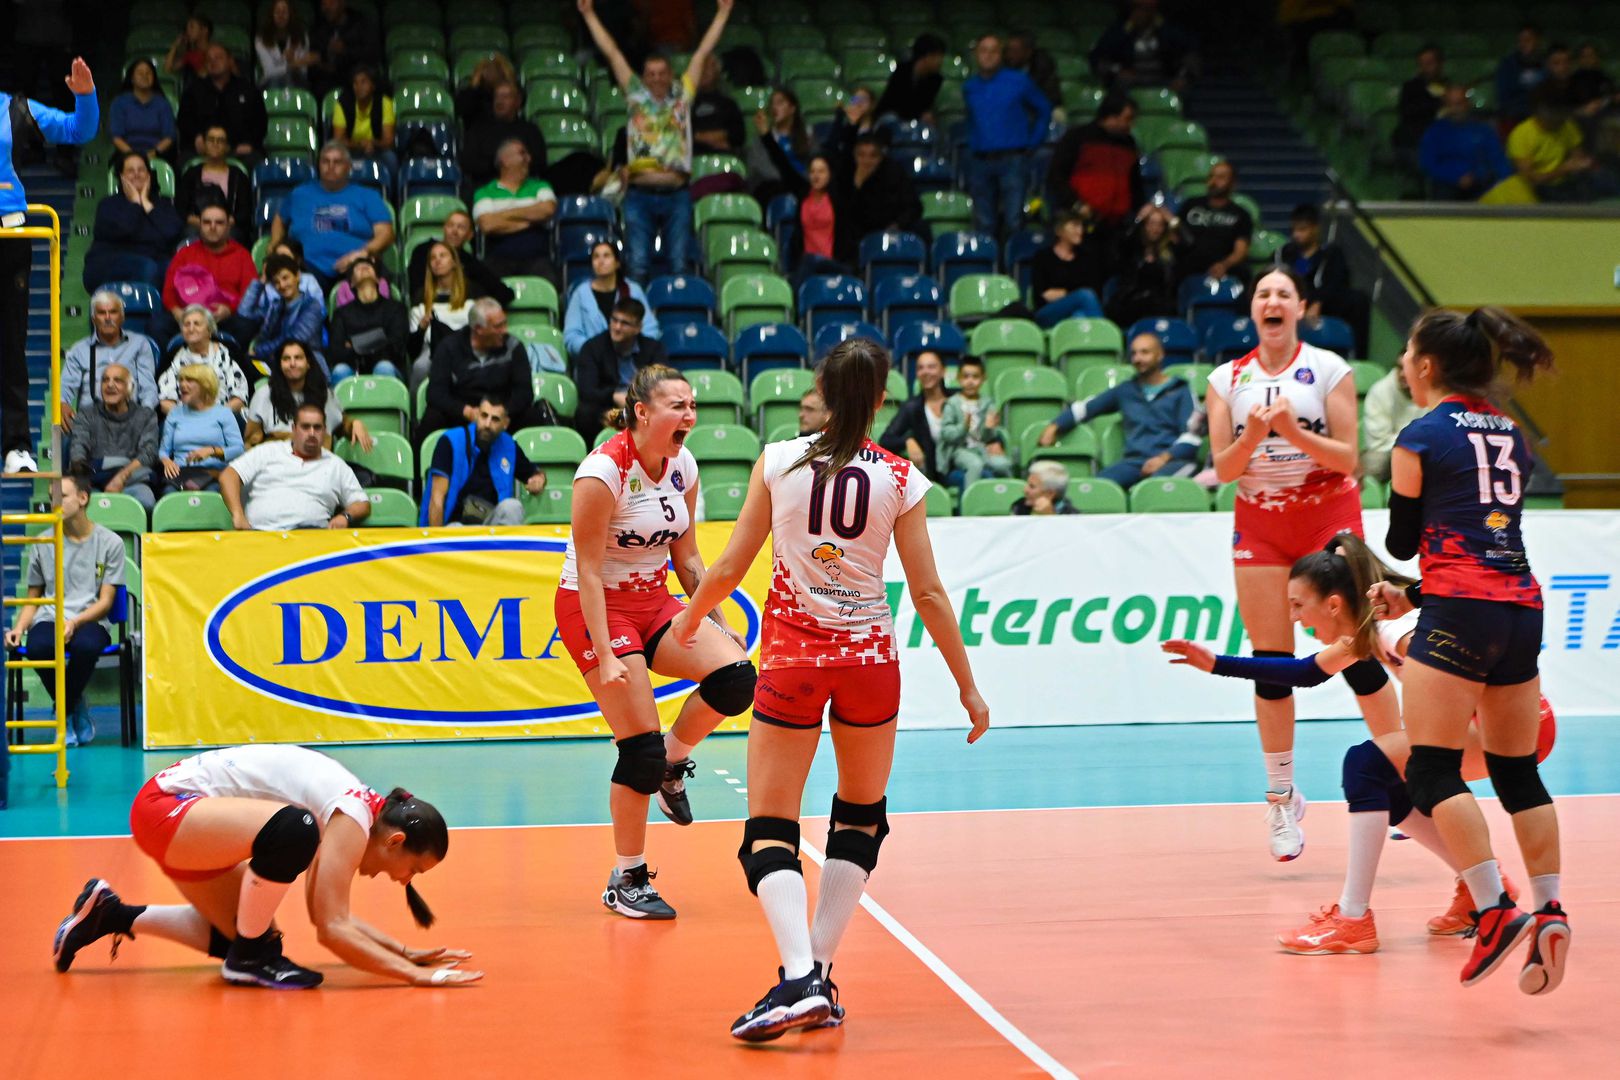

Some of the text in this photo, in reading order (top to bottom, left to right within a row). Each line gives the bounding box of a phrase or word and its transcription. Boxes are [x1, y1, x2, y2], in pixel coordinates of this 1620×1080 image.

[807, 459, 871, 541] 10
[1467, 432, 1521, 506] 13
[658, 496, 676, 523] 5
[809, 586, 861, 598] ПОЗИТАНО
[882, 582, 1254, 656] tercom
